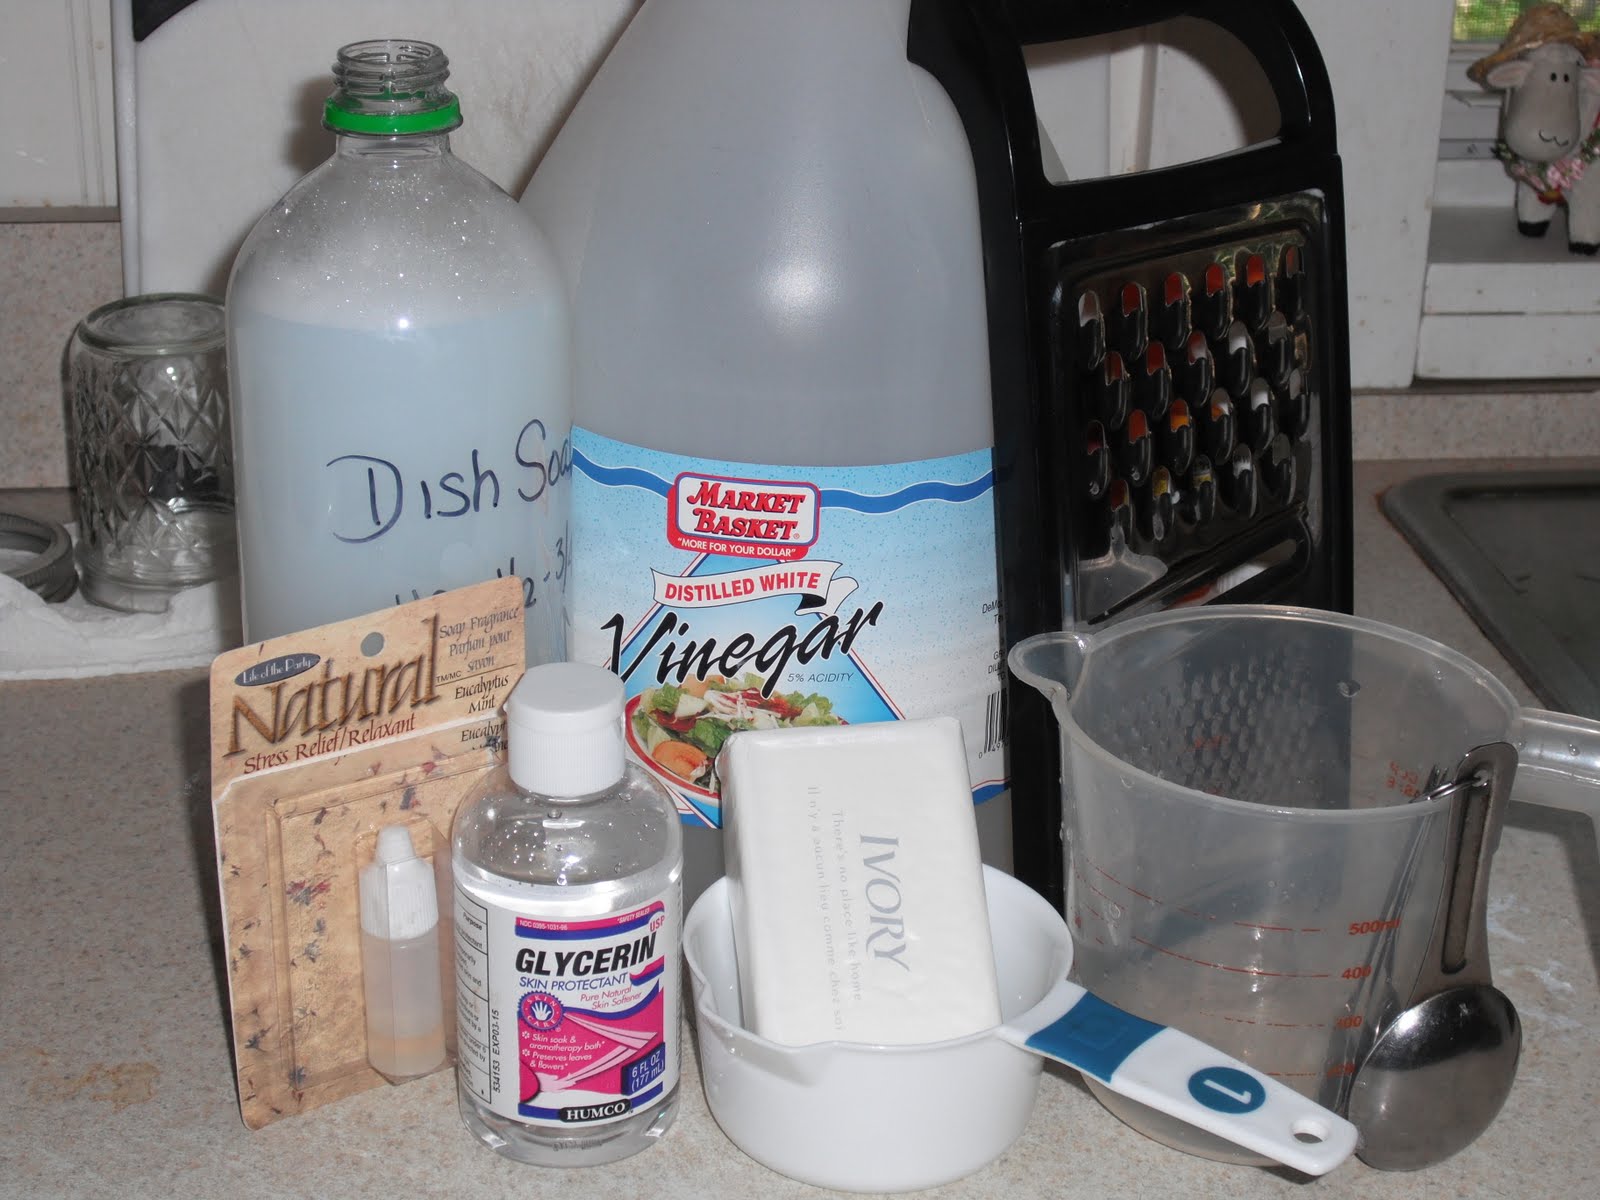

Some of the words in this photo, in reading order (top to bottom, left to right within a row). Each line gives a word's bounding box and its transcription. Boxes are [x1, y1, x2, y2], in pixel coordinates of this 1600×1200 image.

[326, 448, 500, 544] Dish
[515, 418, 573, 502] Soa
[687, 481, 806, 514] MARKET
[692, 507, 799, 540] BASKET
[709, 542, 727, 552] FOR
[730, 544, 756, 555] YOUR
[664, 577, 755, 602] DISTILLED
[759, 571, 822, 592] WHITE
[439, 620, 466, 641] Soap
[470, 607, 520, 633] Fragrance
[449, 633, 485, 660] Parfum
[487, 629, 512, 654] pour
[600, 601, 884, 699] Vinegar
[467, 655, 495, 673] savon
[222, 611, 442, 758] Natural
[454, 674, 509, 700] Eucalyptus
[786, 673, 804, 683] 5%
[807, 672, 855, 683] ACIDITY
[468, 694, 496, 714] Mint
[243, 750, 288, 775] Stress
[839, 866, 848, 882] no
[840, 888, 855, 928] place
[859, 833, 911, 972] IVORY
[649, 915, 665, 932] USP
[515, 931, 657, 977] GLYCERIN
[822, 917, 836, 966] comme
[847, 932, 857, 958] like
[519, 976, 548, 990] SKIN
[551, 972, 628, 991] PROTECTANT
[849, 961, 862, 1000] home
[1341, 965, 1372, 980] 400
[526, 995, 558, 1007] SKIN
[580, 993, 600, 1002] Pure
[601, 985, 632, 1000] Natural
[591, 1000, 609, 1010] Skin
[610, 992, 643, 1006] Softener
[491, 1008, 501, 1056] EXP03-15
[532, 1033, 548, 1043] Skin
[550, 1036, 568, 1044] soak
[569, 1036, 577, 1044] &
[529, 1042, 583, 1053] aromatherapy
[532, 1051, 568, 1061] Preserves
[568, 1051, 593, 1061] leaves
[529, 1060, 537, 1068] &
[631, 1067, 638, 1077] 6
[639, 1062, 649, 1075] FL
[650, 1050, 661, 1066] OZ
[631, 1074, 650, 1093] (177
[650, 1060, 665, 1078] mL)
[493, 1060, 501, 1094] 534153
[1203, 1079, 1252, 1105] 1
[566, 1102, 626, 1121] HUMCO
